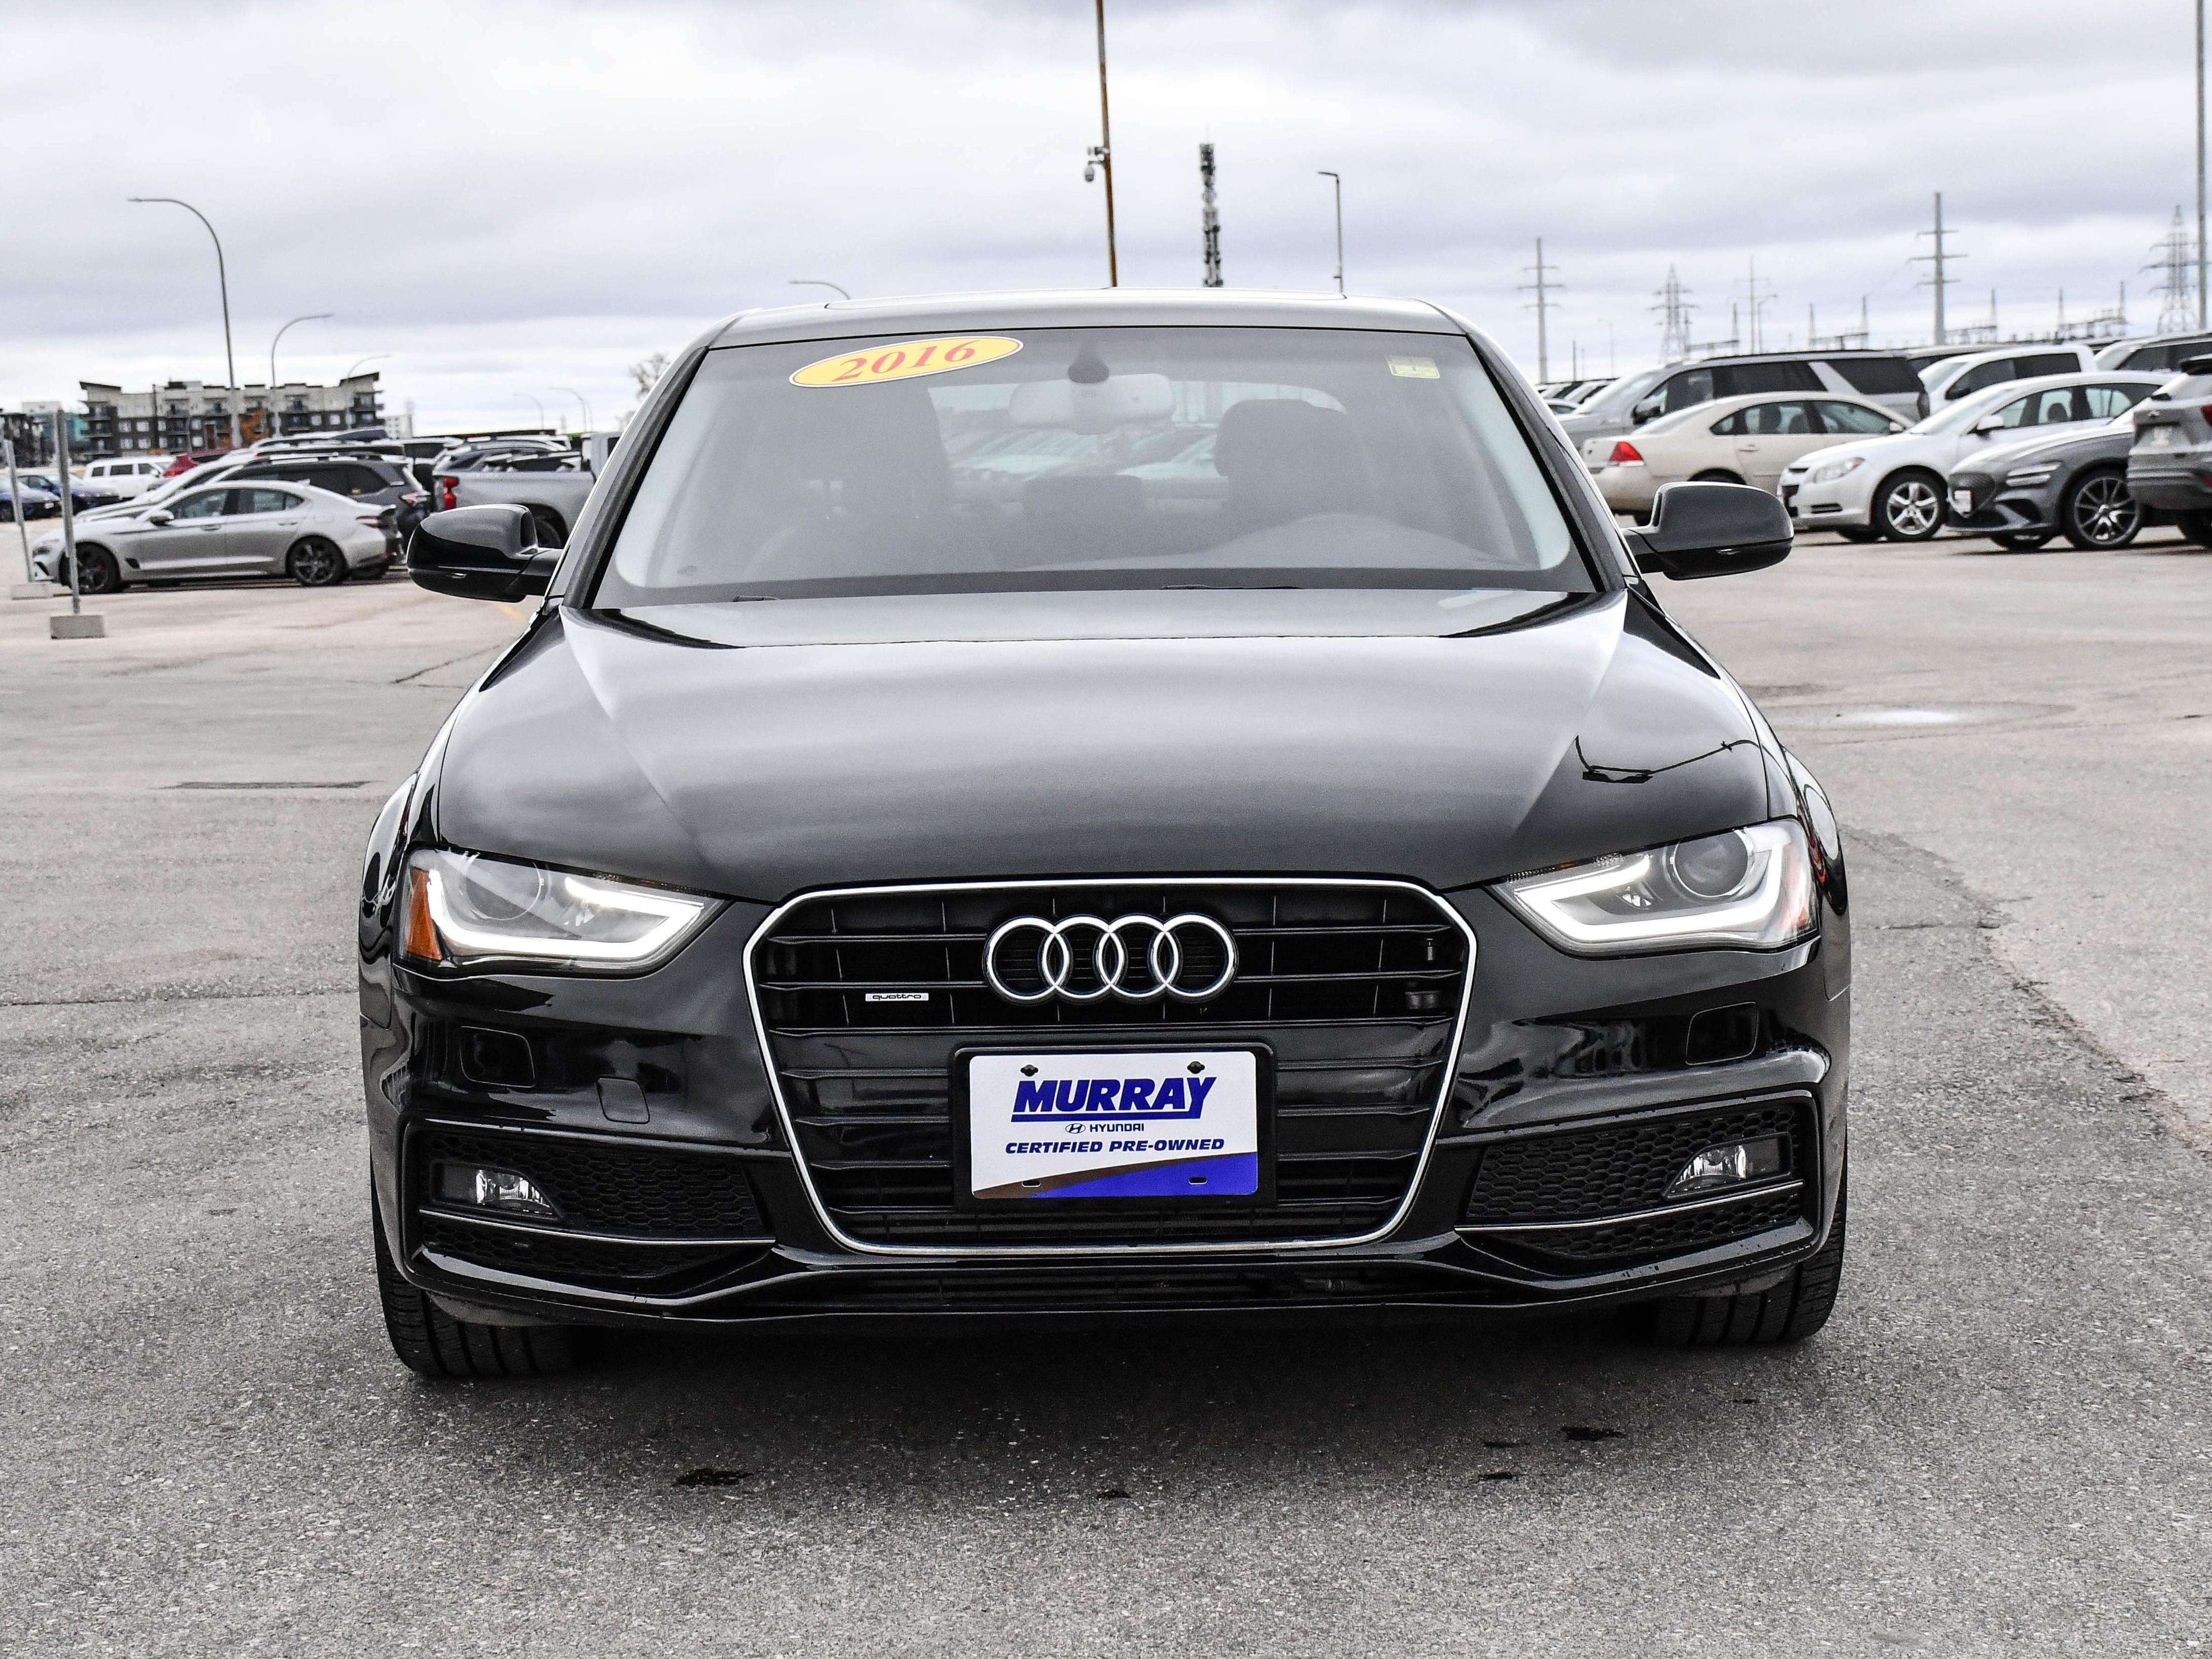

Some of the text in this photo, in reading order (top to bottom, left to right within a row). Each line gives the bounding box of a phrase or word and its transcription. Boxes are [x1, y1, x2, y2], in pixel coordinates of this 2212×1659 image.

[831, 340, 980, 382] 2016
[1011, 1077, 1217, 1122] MURRAY
[1090, 1123, 1144, 1132] HYUNDAI
[1005, 1138, 1225, 1154] CERTIFIED PRE-OWNED
